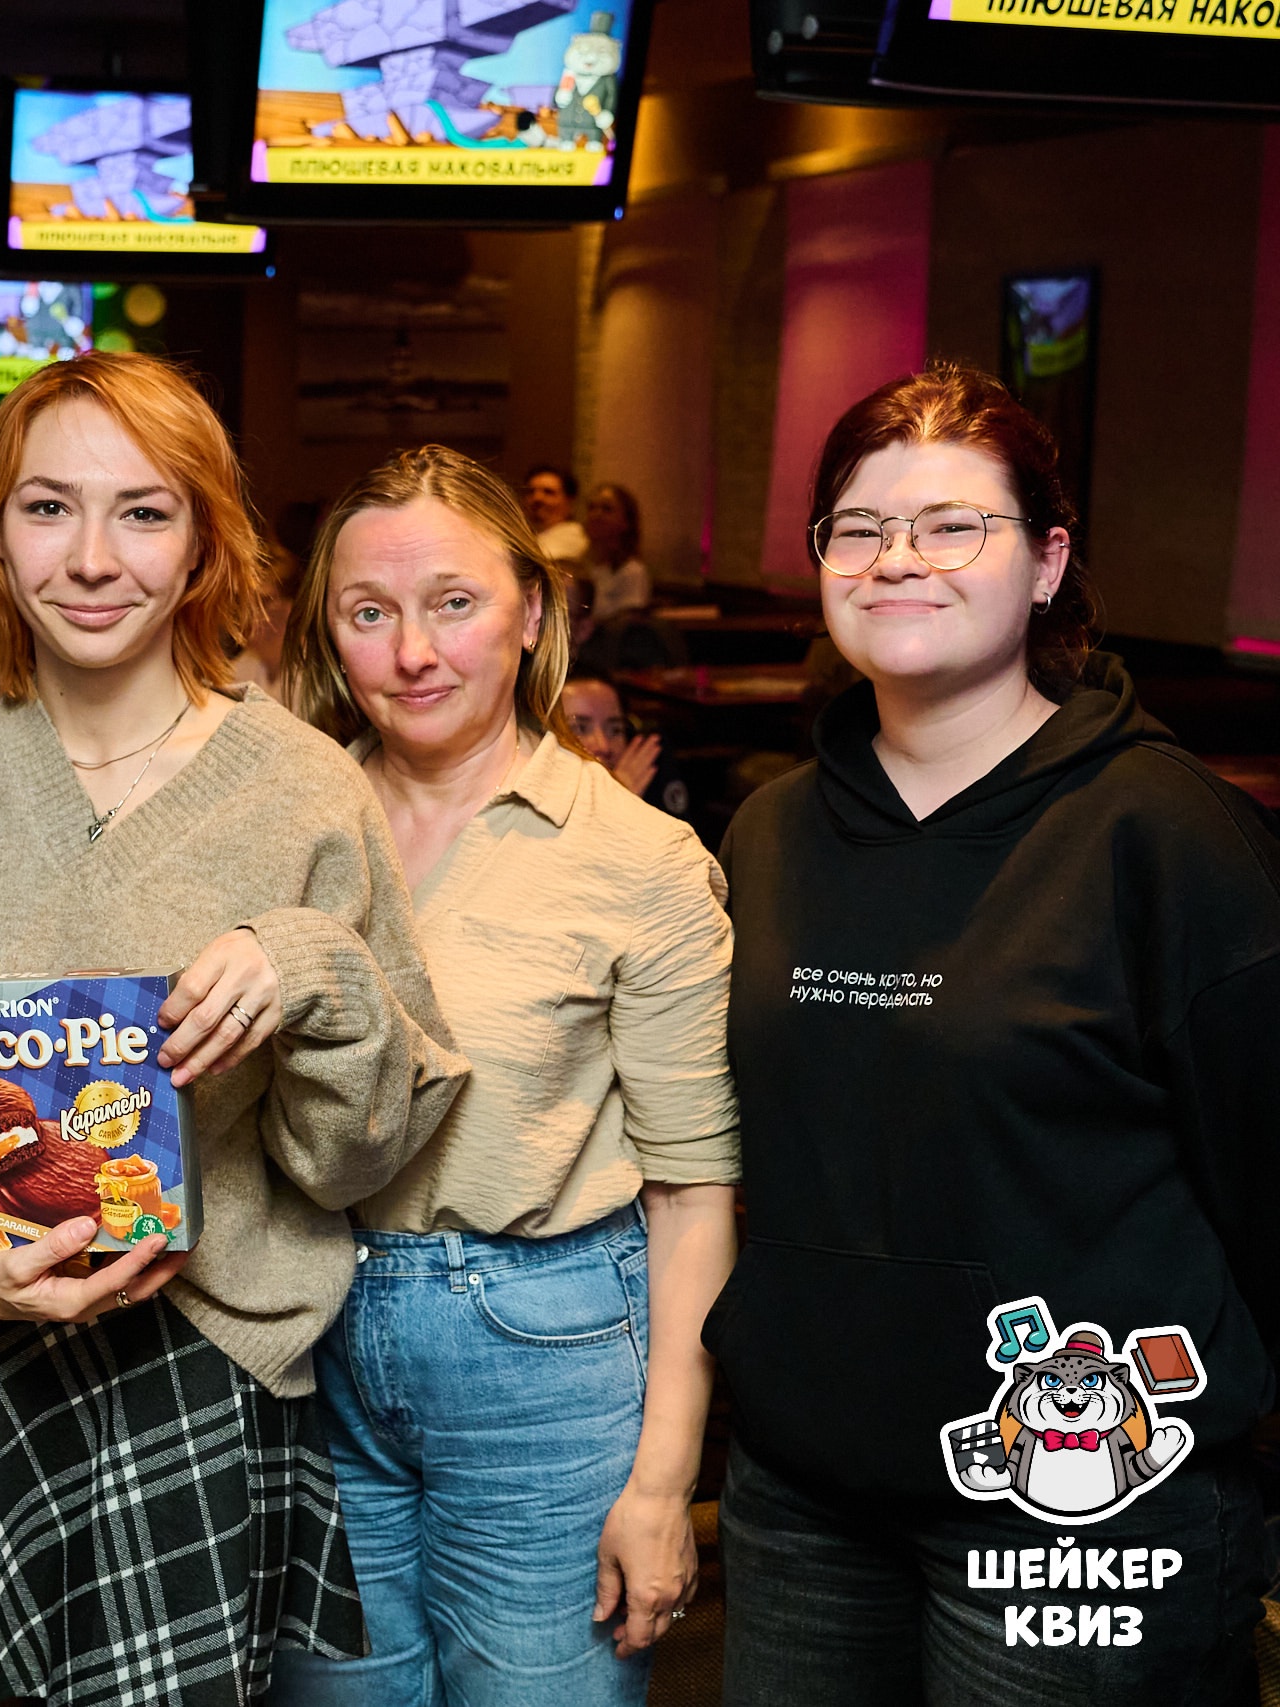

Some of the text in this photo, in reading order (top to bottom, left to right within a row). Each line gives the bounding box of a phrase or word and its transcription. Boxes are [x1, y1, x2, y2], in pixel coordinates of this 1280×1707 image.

[1188, 0, 1280, 28] НАКО
[289, 158, 421, 175] ПЛЮШЕВАЯ
[792, 966, 943, 990] все очень круто, но
[789, 985, 934, 1010] нужно переделать
[59, 1085, 152, 1142] Карамель
[97, 1123, 129, 1140] CARAMEL
